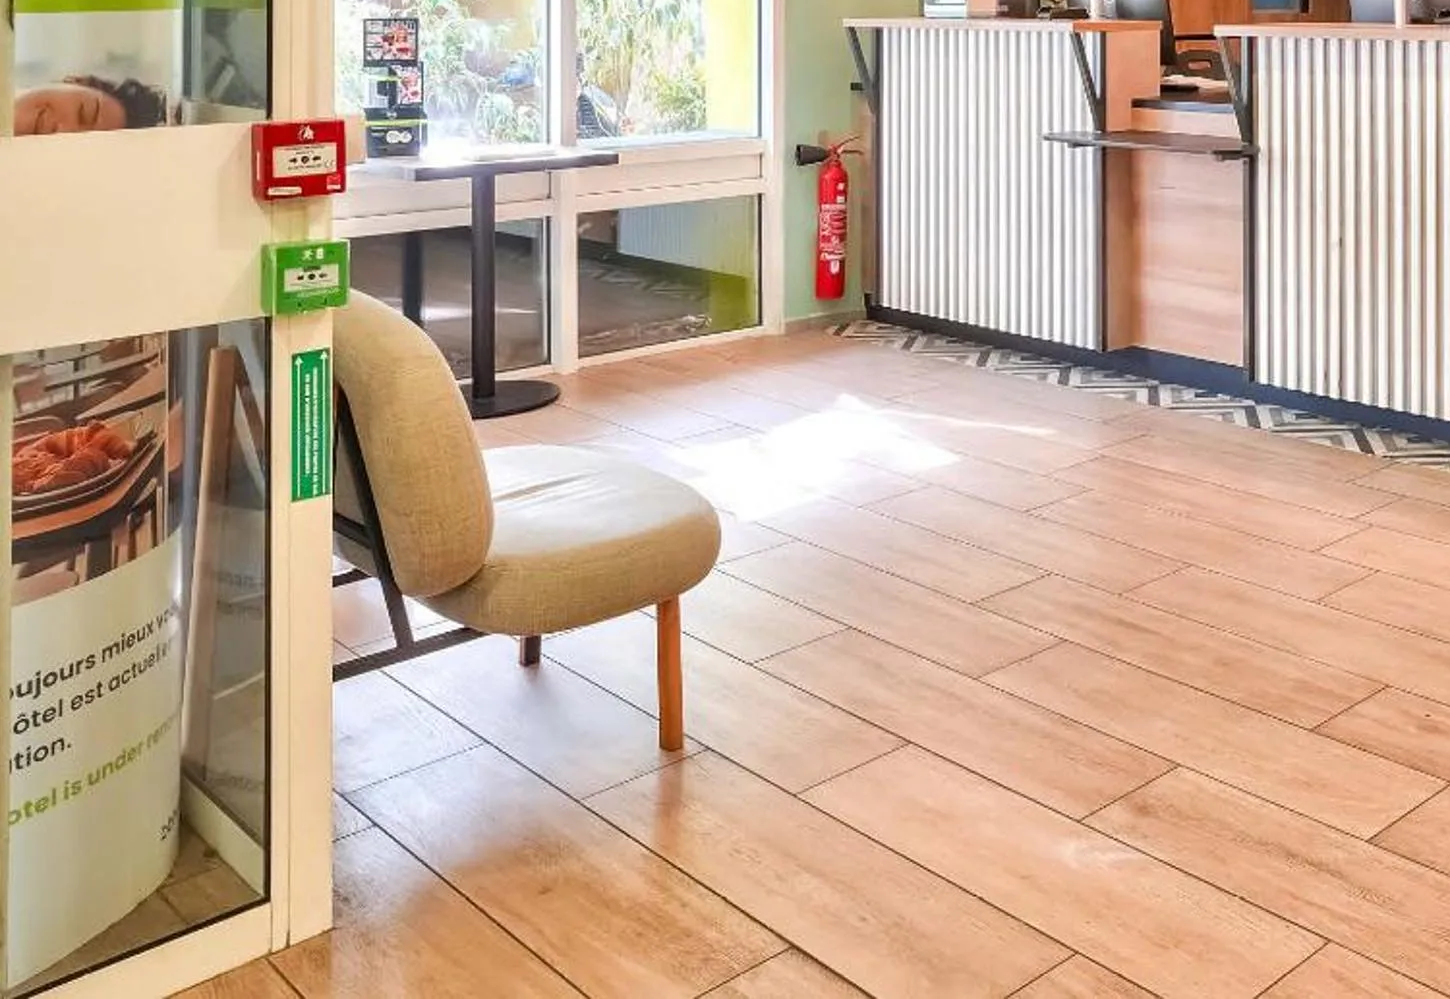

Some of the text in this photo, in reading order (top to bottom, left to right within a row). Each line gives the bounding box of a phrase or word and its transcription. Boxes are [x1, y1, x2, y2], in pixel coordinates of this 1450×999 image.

[102, 619, 154, 663] mieux
[70, 681, 103, 712] est
[10, 737, 72, 775] tion.
[63, 780, 82, 800] is
[88, 741, 143, 786] under
